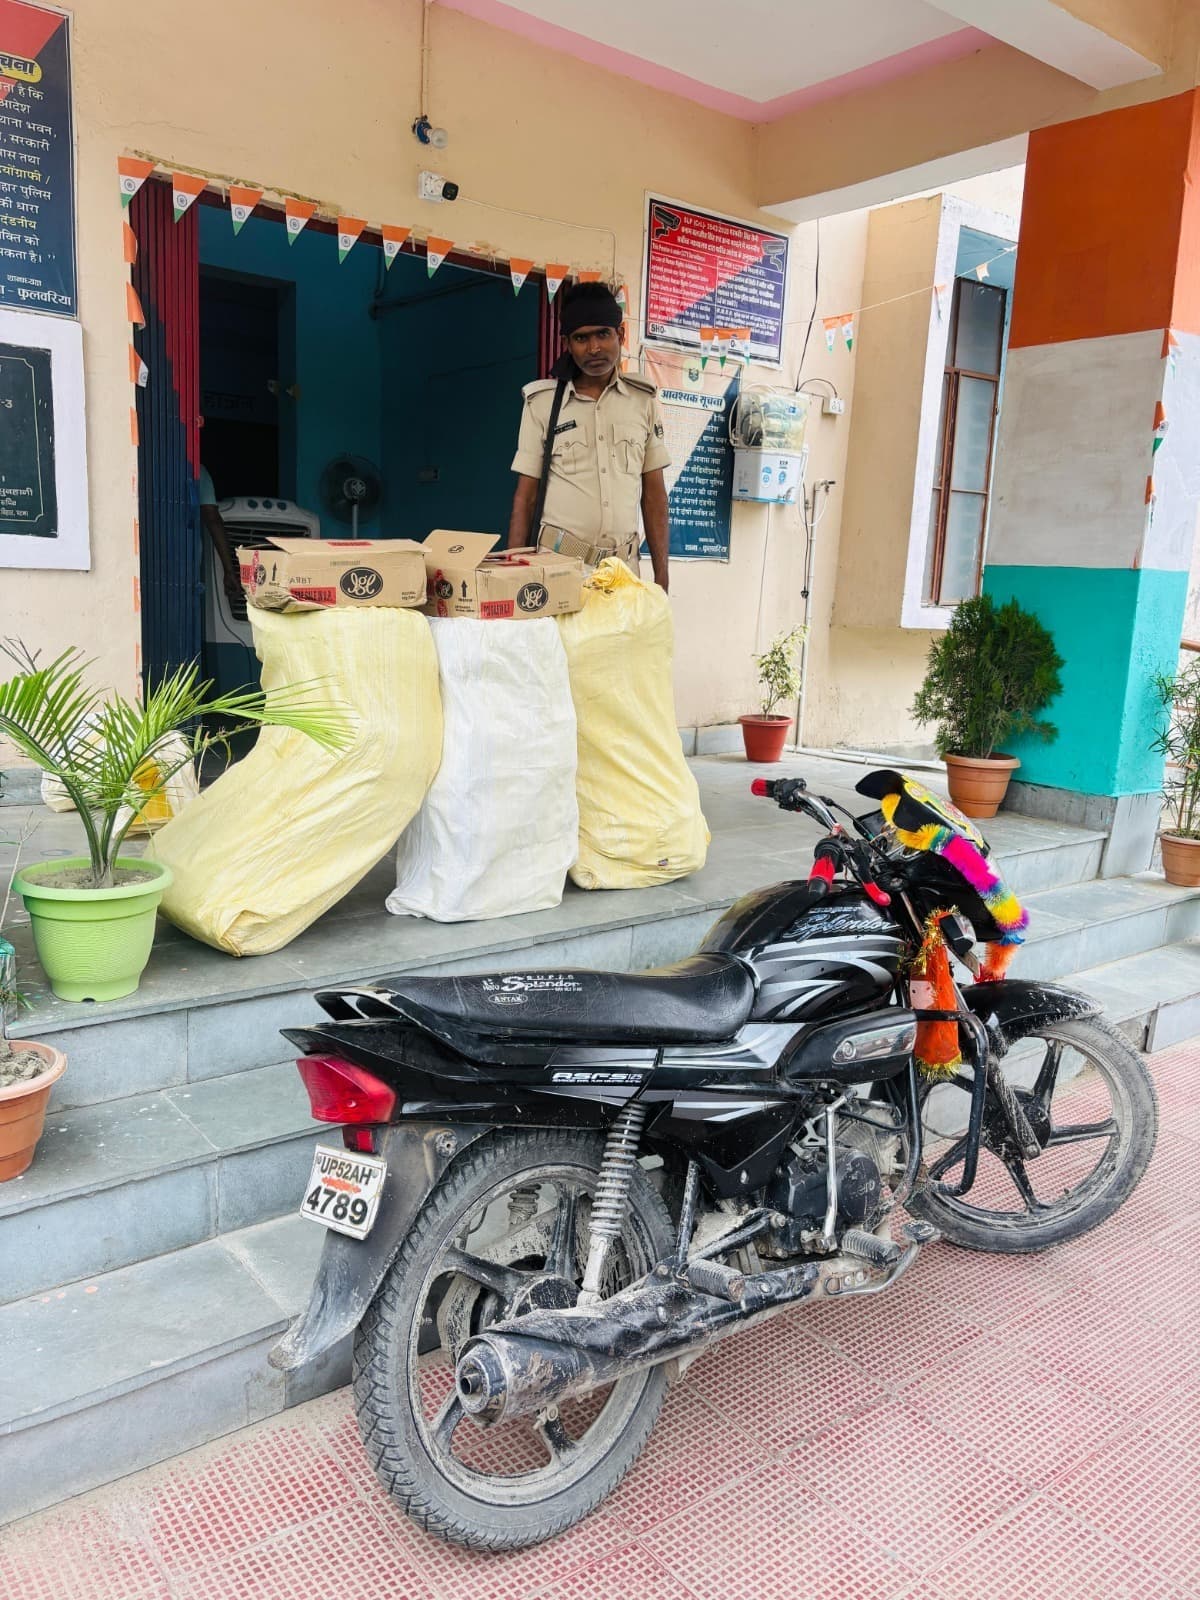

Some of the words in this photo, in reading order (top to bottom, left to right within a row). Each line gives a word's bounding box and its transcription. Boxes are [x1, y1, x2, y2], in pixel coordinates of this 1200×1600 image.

[9, 133, 50, 151] सरकारी
[19, 152, 40, 165] तथा
[20, 184, 53, 200] पुलिस
[16, 202, 40, 214] धारा
[24, 234, 40, 246] को
[17, 287, 72, 306] फुलवरिया
[661, 389, 698, 403] आवश्यक
[700, 395, 723, 409] सूचना
[782, 912, 903, 944] Splendor
[501, 976, 583, 992] Splendor
[320, 1155, 373, 1186] UP52AH
[306, 1185, 369, 1225] 4789
